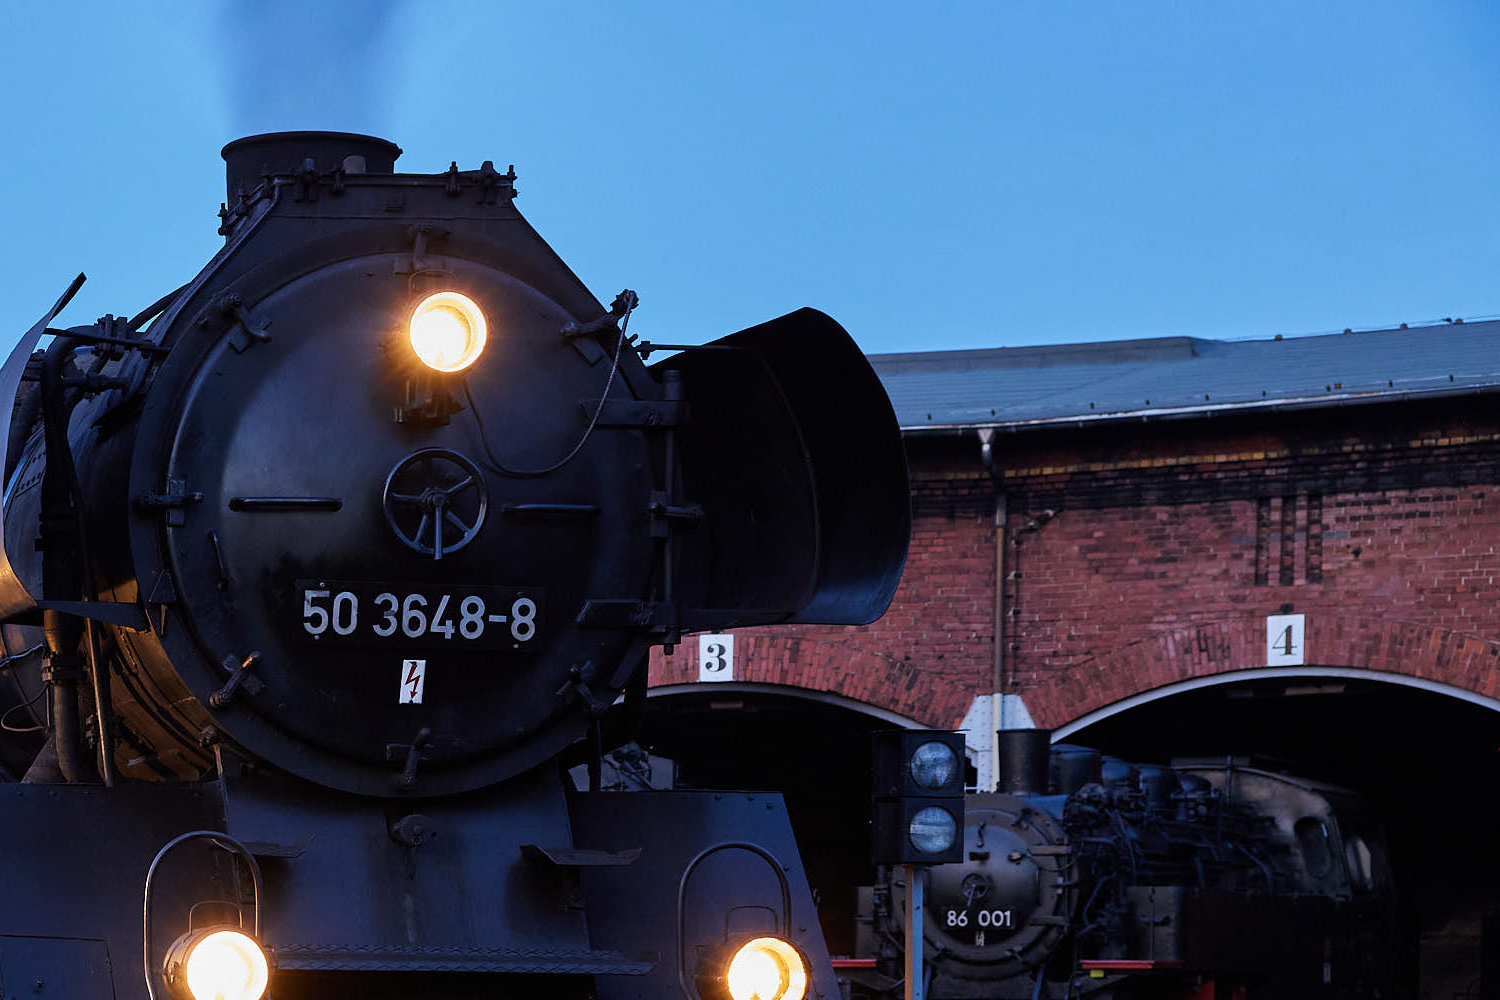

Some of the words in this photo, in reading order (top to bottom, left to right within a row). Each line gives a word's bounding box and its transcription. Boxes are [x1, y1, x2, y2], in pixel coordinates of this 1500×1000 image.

[302, 589, 359, 636] 50
[372, 592, 537, 642] 3648-8
[1271, 624, 1298, 656] 4
[705, 643, 727, 673] 3
[947, 909, 969, 927] 86
[978, 909, 1012, 927] 001
